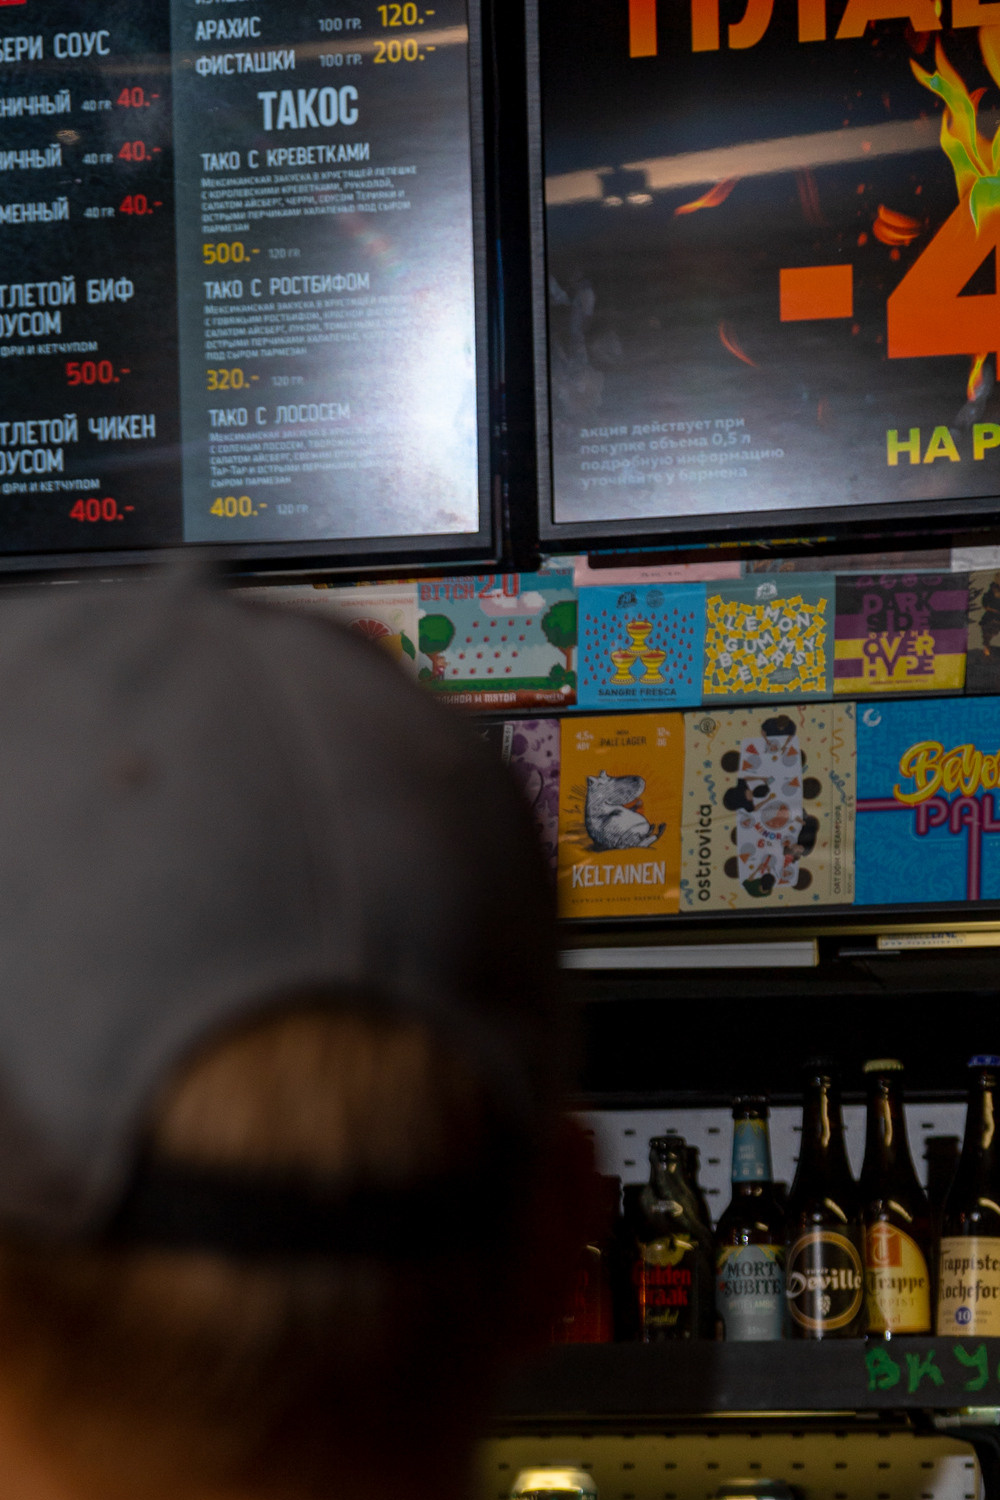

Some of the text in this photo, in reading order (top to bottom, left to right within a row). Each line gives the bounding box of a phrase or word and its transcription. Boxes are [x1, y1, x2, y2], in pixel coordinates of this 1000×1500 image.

[194, 16, 261, 42] АРАХИС
[318, 18, 343, 32] 100
[377, 2, 436, 27] 120.-
[53, 30, 111, 59] СОУС
[195, 49, 296, 77] ФИСТАШКИ
[319, 54, 344, 68] 100
[373, 38, 436, 64] 200.-
[117, 87, 160, 108] 40.-
[257, 85, 359, 132] ТАКОС
[118, 140, 161, 162] 40.-
[201, 143, 370, 172] ТАКО С КРЕВЕТКАМИ
[120, 194, 163, 215] 40.-
[203, 241, 260, 264] 500.-
[86, 276, 135, 304] БИФ
[204, 272, 370, 300] ТАКО С РОСТБИФОМ
[65, 360, 131, 387] 500.-
[207, 368, 260, 391] 320.-
[88, 414, 156, 442] ЧИКЕН
[209, 402, 351, 427] ТАКО С ЛОСОСЕМ
[887, 425, 961, 466] НА
[69, 497, 135, 523] 400.-
[210, 496, 268, 518] 400.-
[420, 583, 475, 601] BITCH
[726, 605, 812, 632] LEMON
[725, 631, 815, 655] GUMMY
[863, 634, 936, 663] OVER
[719, 651, 807, 683] BEARS
[862, 656, 936, 678] HYPE
[598, 686, 677, 697] SANGRE FRESCA
[893, 740, 1000, 806] Beyo
[695, 804, 713, 901] ostrovica
[572, 860, 666, 888] KELTAINEN
[727, 1261, 776, 1278] MORT
[724, 1279, 781, 1297] SUBITE
[957, 1310, 970, 1322] 10
[865, 1343, 1000, 1394] ВКУ
